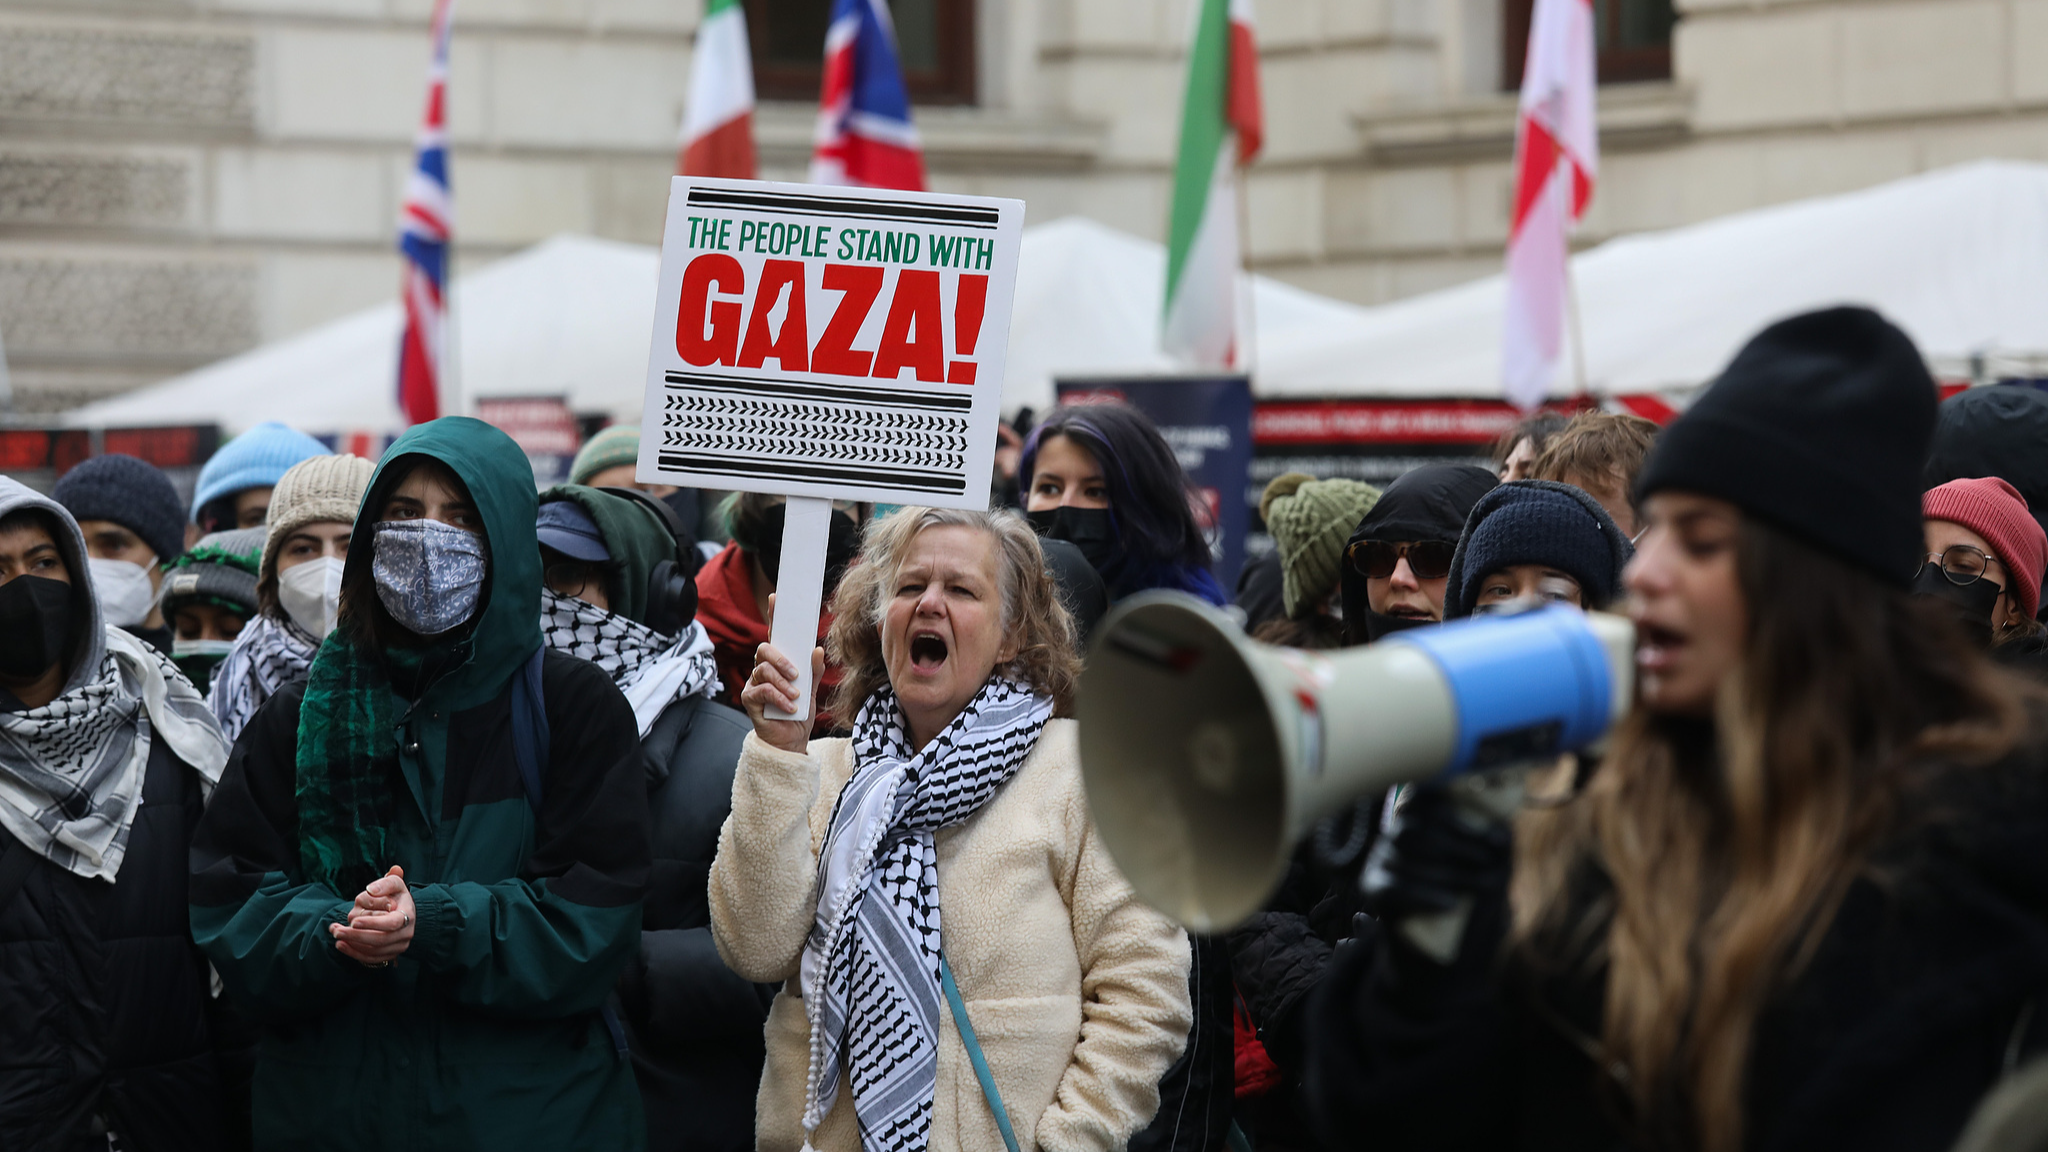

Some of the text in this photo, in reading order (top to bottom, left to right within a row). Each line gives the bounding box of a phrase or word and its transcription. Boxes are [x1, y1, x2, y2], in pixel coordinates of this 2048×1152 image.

[688, 216, 994, 271] THE PEOPLE STAND WITH
[675, 253, 989, 386] GAZA!
